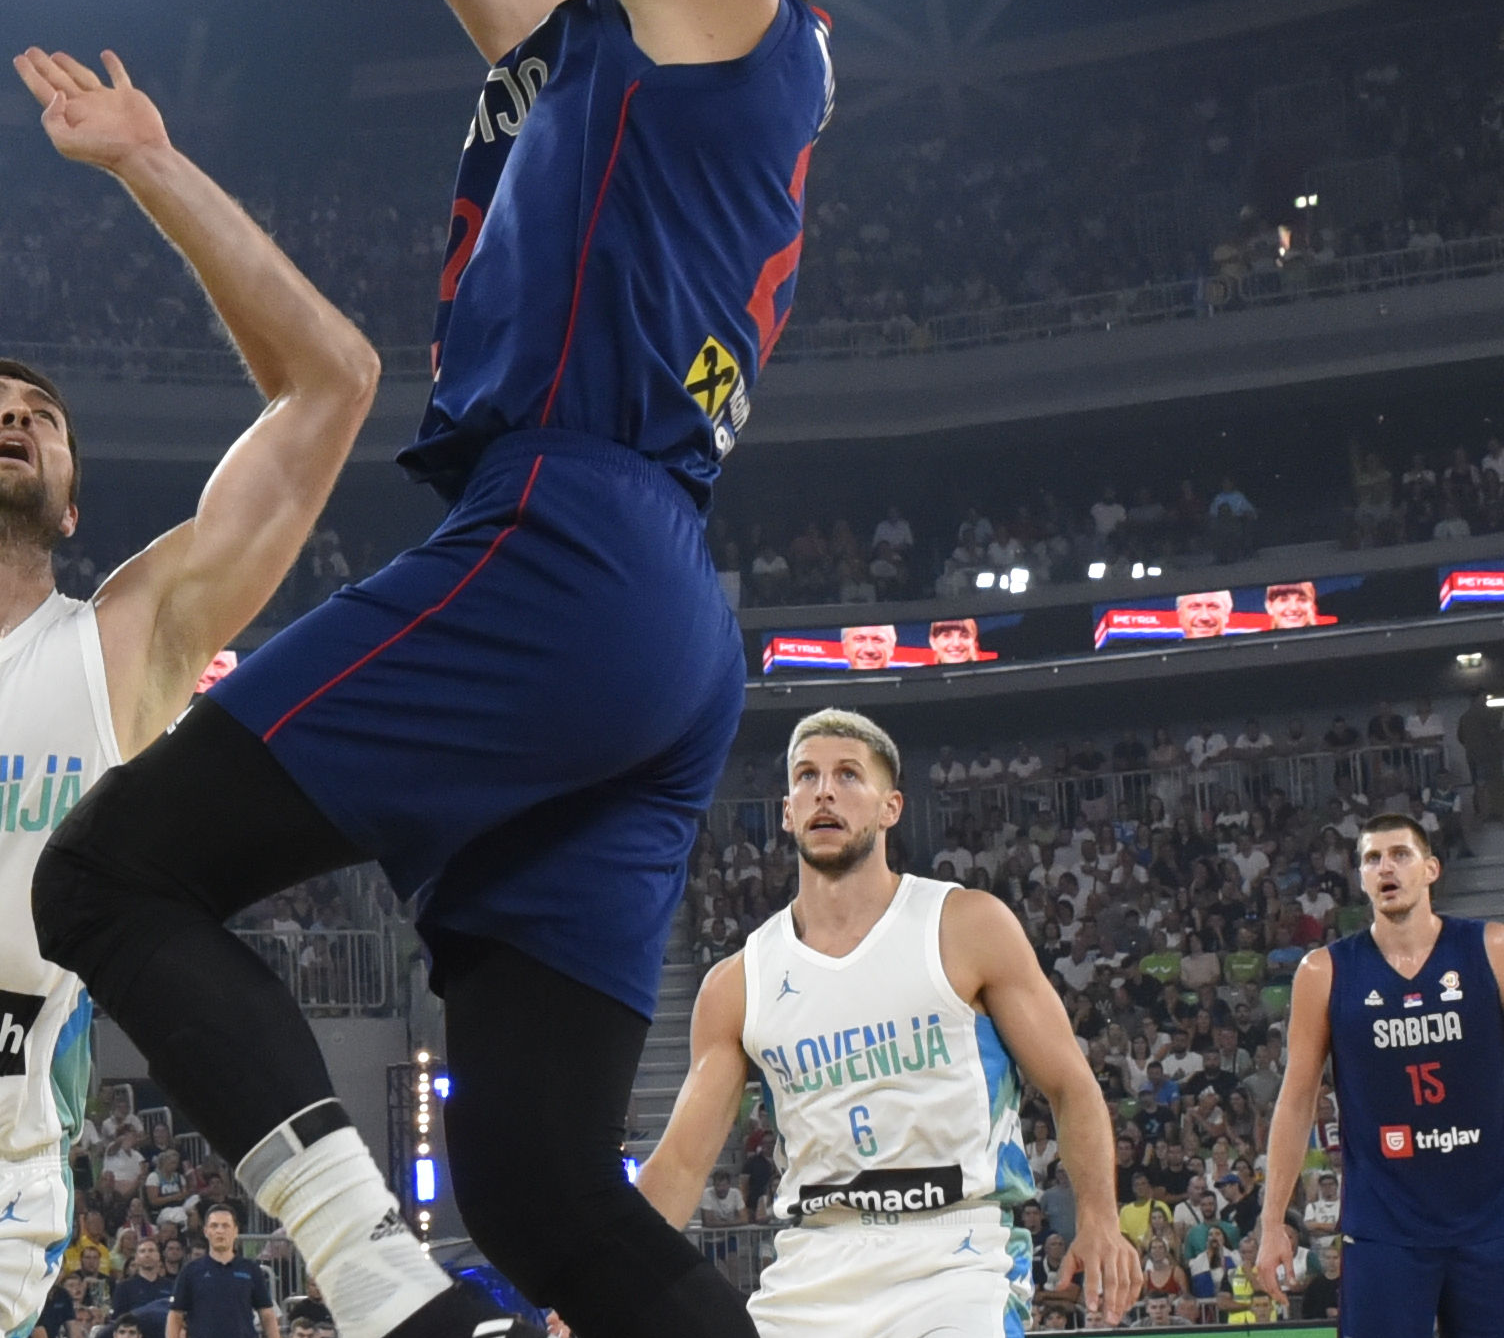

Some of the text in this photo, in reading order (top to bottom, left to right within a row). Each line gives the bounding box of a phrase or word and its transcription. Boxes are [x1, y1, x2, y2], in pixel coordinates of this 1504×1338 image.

[1112, 614, 1161, 626] PETROL
[778, 644, 827, 656] PETROL
[1373, 1011, 1463, 1049] SRBIJA
[761, 1014, 952, 1095] SLOVENIJA
[1405, 1062, 1446, 1106] 15
[849, 1105, 878, 1157] 6
[1415, 1126, 1481, 1153] triglav
[861, 1213, 900, 1226] SLO
